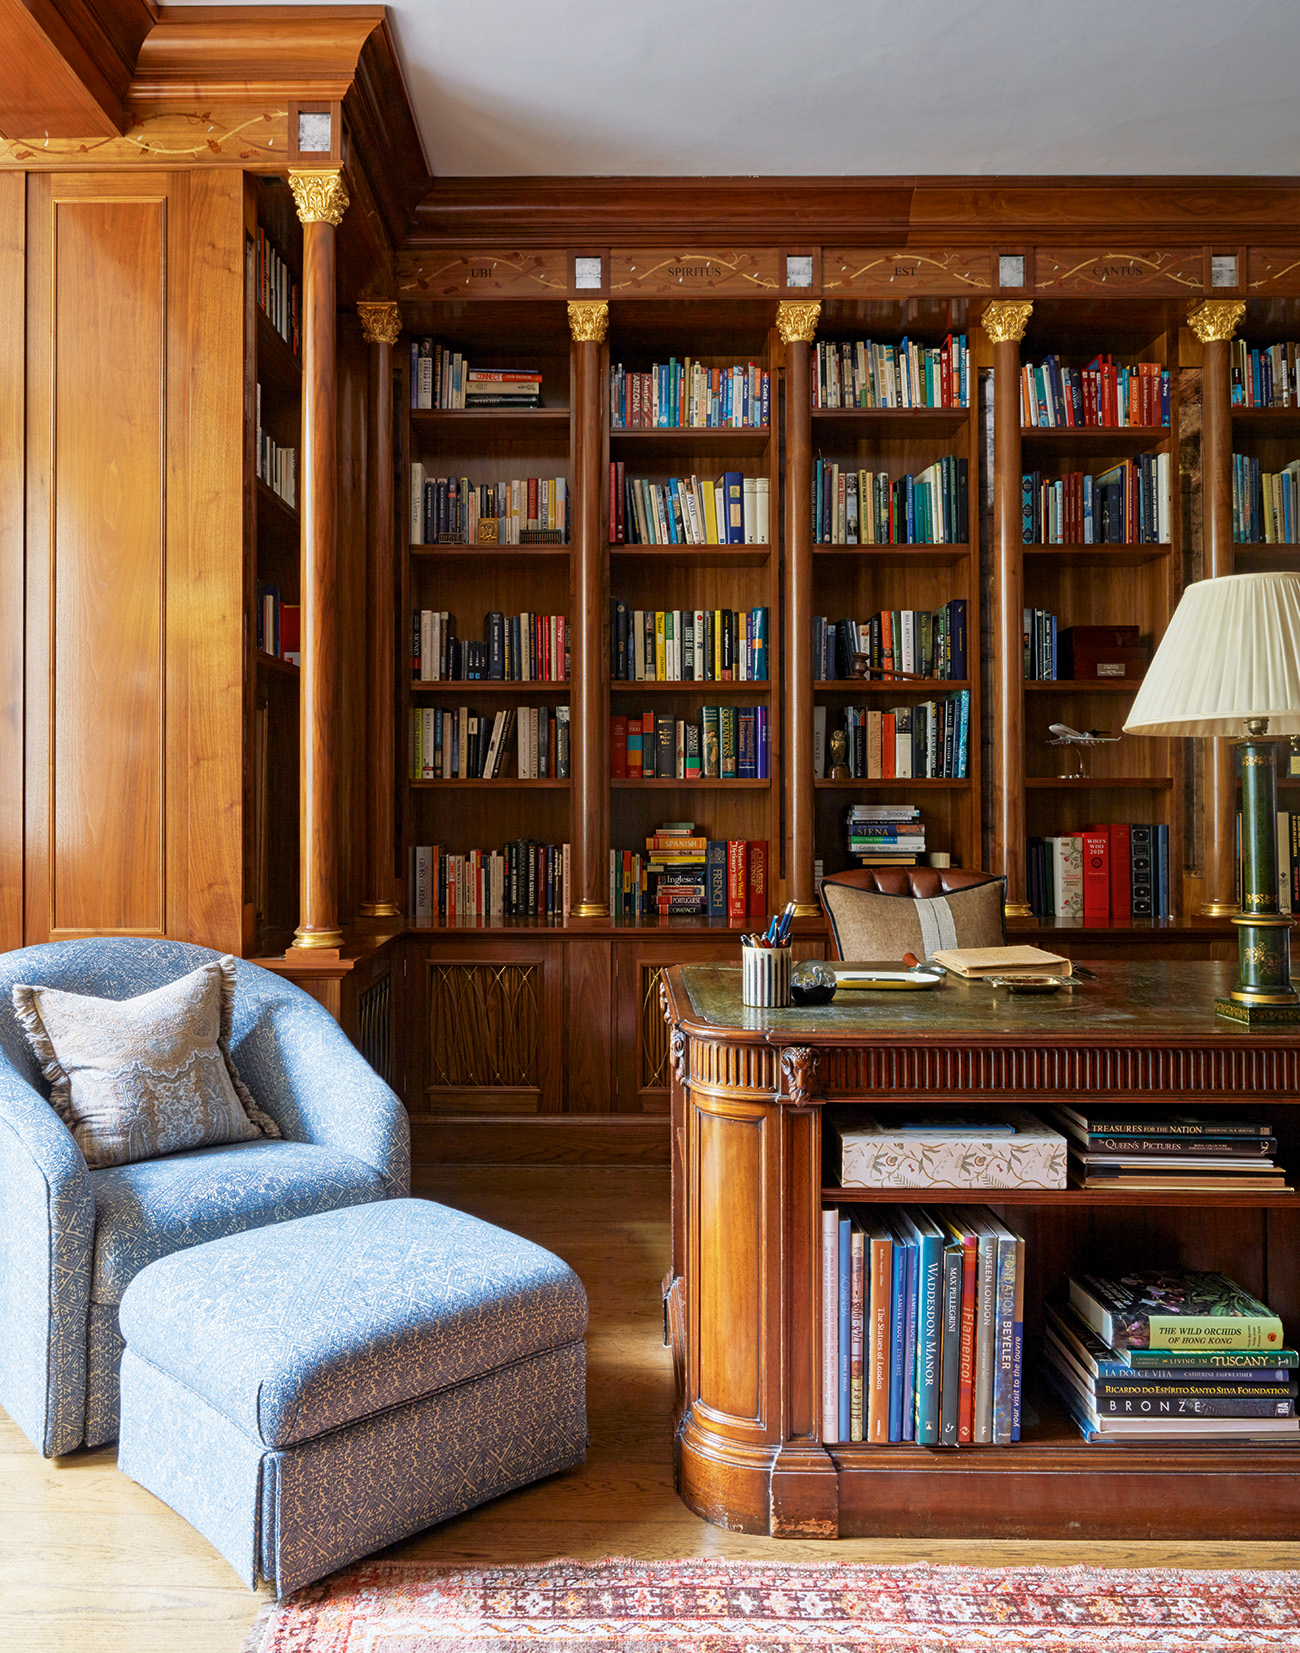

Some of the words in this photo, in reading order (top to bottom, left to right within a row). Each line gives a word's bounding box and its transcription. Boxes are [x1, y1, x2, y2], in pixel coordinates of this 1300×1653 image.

[471, 268, 492, 278] UBI
[668, 266, 721, 277] SPIRITUS
[894, 267, 917, 277] EST
[1093, 265, 1142, 277] CANTUS
[476, 372, 500, 380] CONNECT
[685, 626, 693, 641] LORDS
[685, 648, 693, 667] FINANCE
[668, 876, 694, 885] Inglese
[713, 869, 722, 907] FRENCH
[1092, 1124, 1142, 1132] TREASURES
[1169, 1126, 1202, 1134] NATION
[1105, 1139, 1140, 1150] QUEEN'S
[1143, 1141, 1181, 1150] PICTURES
[948, 1267, 957, 1285] MAX
[1003, 1254, 1015, 1317] FONDATION
[926, 1262, 938, 1337] WADDESDON
[984, 1285, 992, 1326] LONDON
[877, 1307, 885, 1322] The
[948, 1287, 956, 1332] PELLEGRINI
[877, 1323, 885, 1351] Statues
[1002, 1322, 1013, 1370] BEYELER
[1013, 1336, 1021, 1361] louvre
[877, 1352, 885, 1360] of
[1210, 1356, 1268, 1366] TUSCANY
[925, 1341, 936, 1387] MANOR
[1013, 1364, 1021, 1377] the
[877, 1362, 885, 1390] London
[1013, 1379, 1021, 1387] to
[1106, 1386, 1139, 1394] RICARDO
[1013, 1390, 1021, 1406] visit
[1110, 1401, 1202, 1412] BRONZE
[1276, 1402, 1289, 1414] RA
[1013, 1409, 1021, 1428] your
